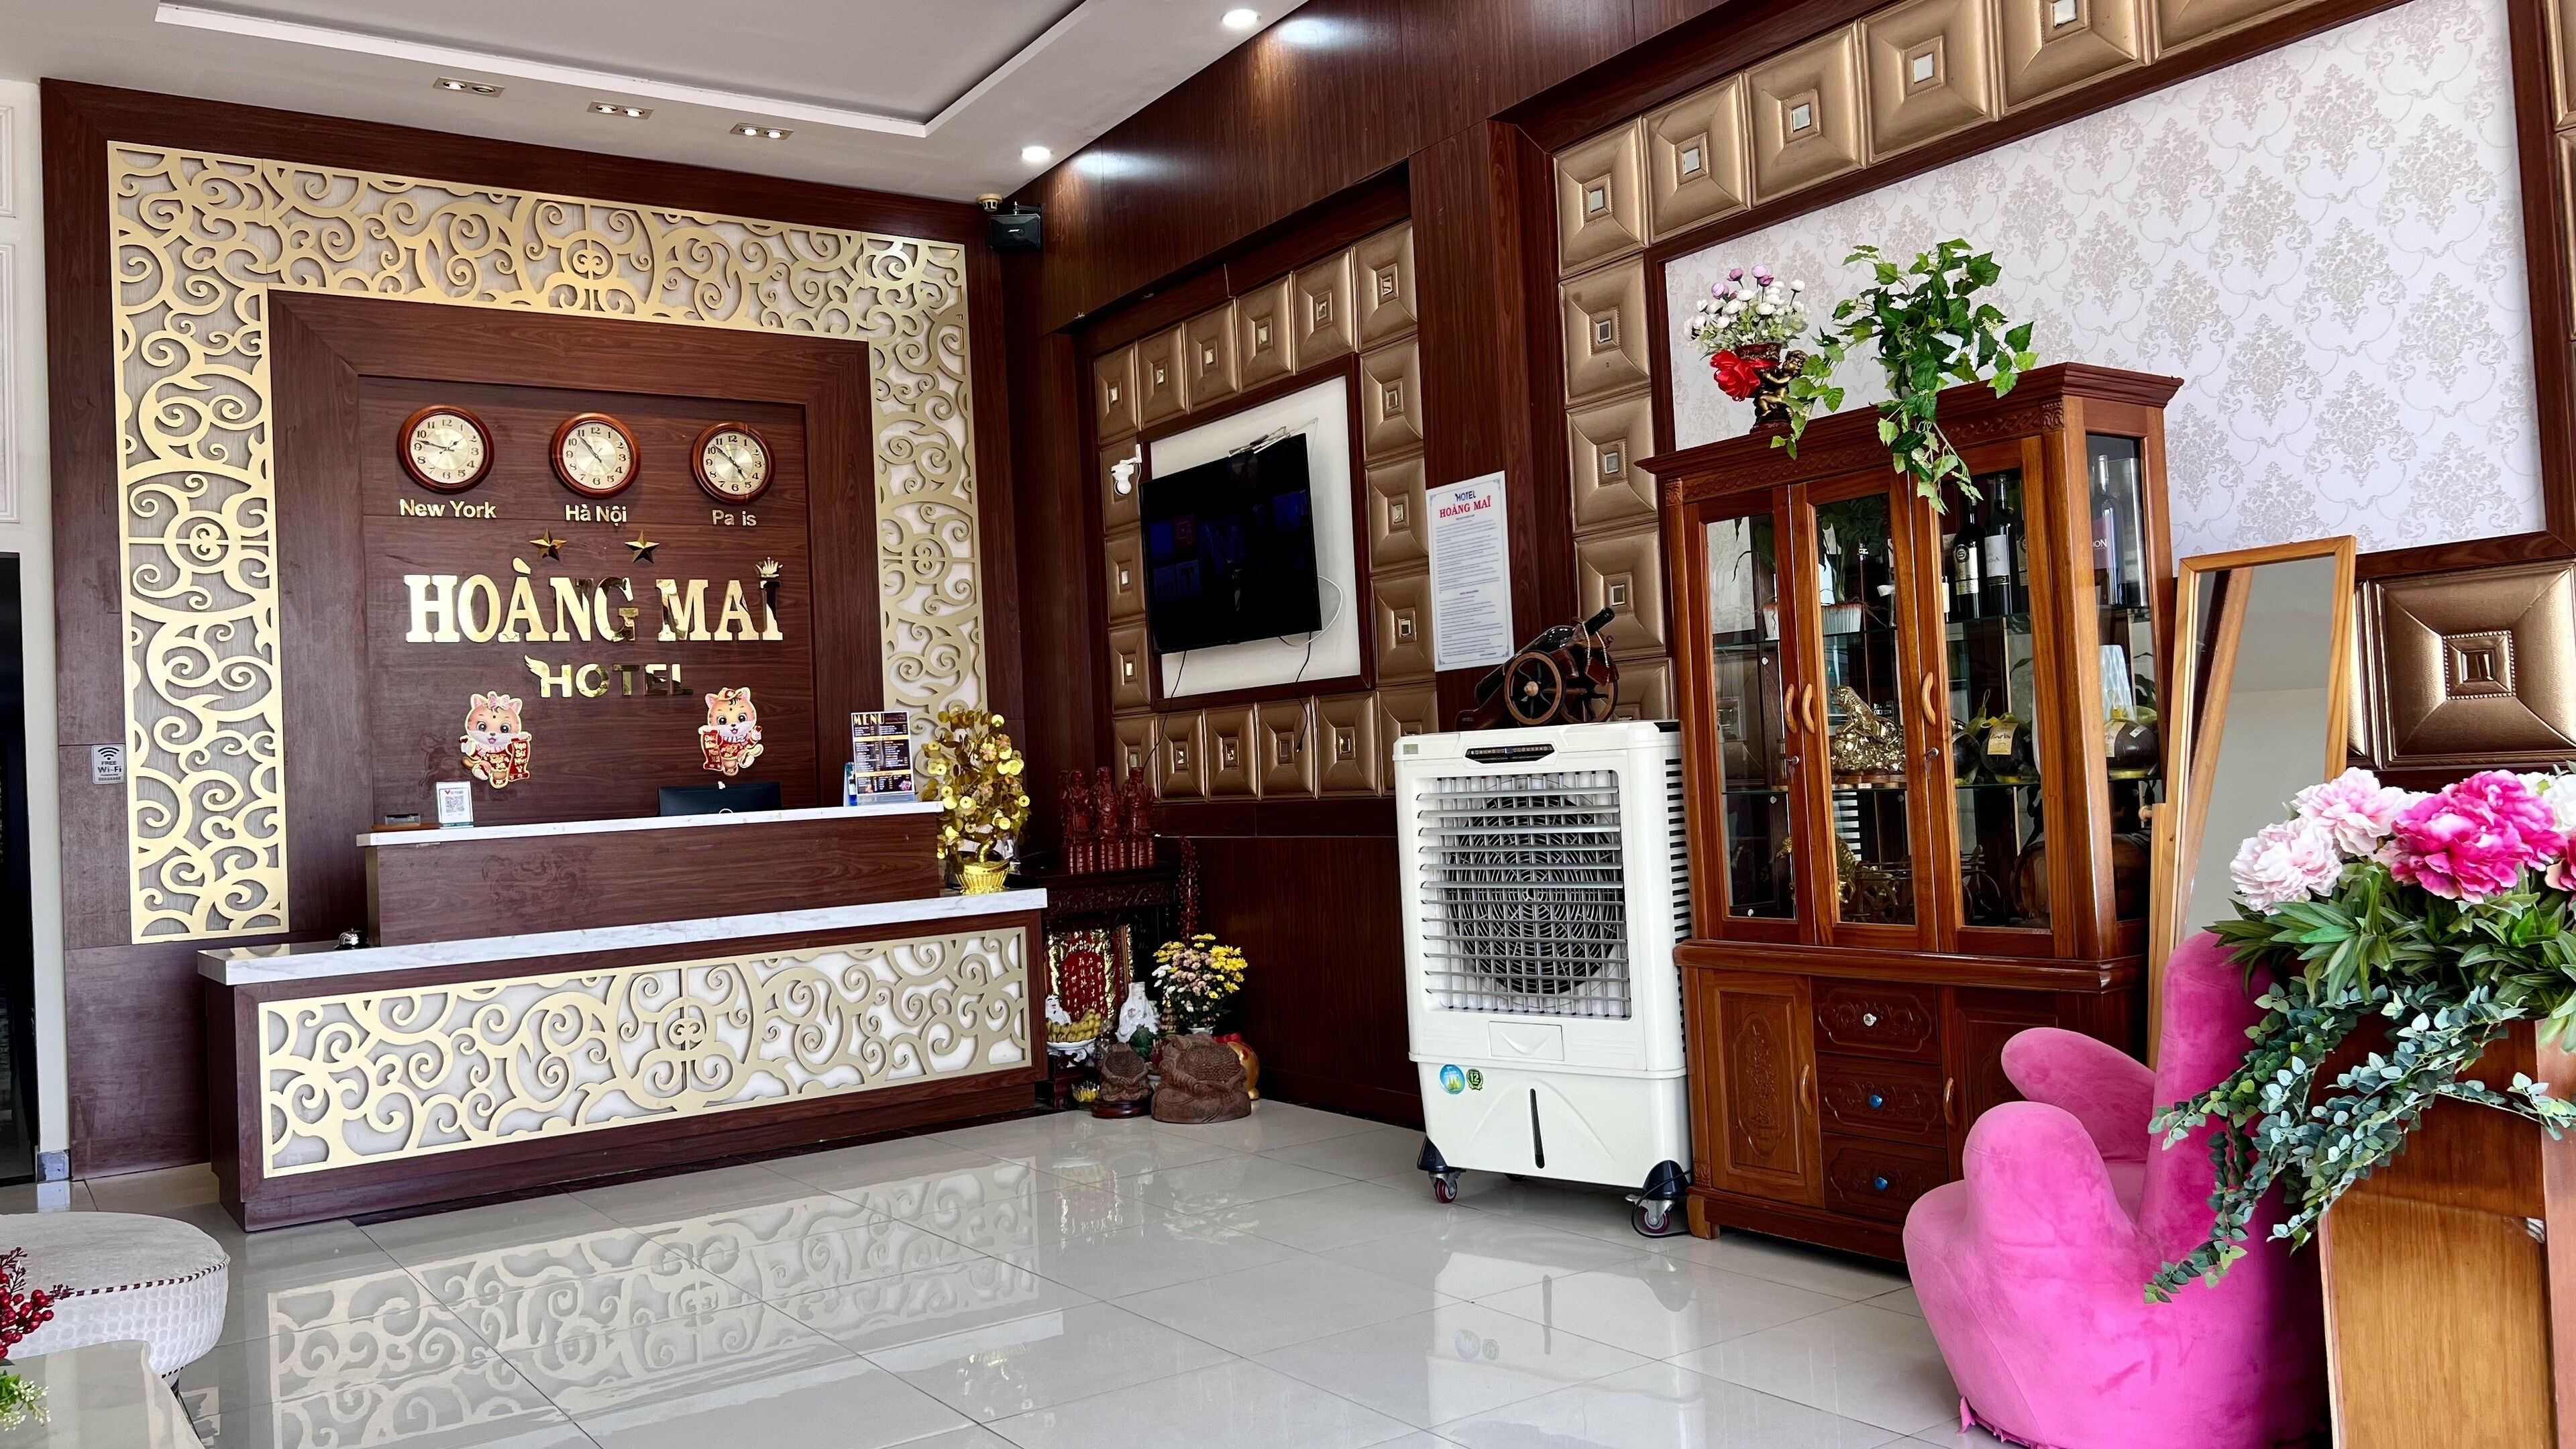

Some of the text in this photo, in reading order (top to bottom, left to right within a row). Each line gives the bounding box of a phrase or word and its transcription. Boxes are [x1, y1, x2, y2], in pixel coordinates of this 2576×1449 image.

[417, 430, 426, 438] 10
[414, 443, 422, 451] 9
[1454, 490, 1476, 502] HOTEL
[399, 498, 496, 519] New York
[565, 504, 627, 526] Hà Nội
[1440, 503, 1470, 518] HOÀNG
[404, 557, 784, 643] HOÀNG MAI
[525, 655, 694, 698] HOTEL
[854, 713, 884, 725] MENU
[1470, 1073, 1479, 1082] 12
